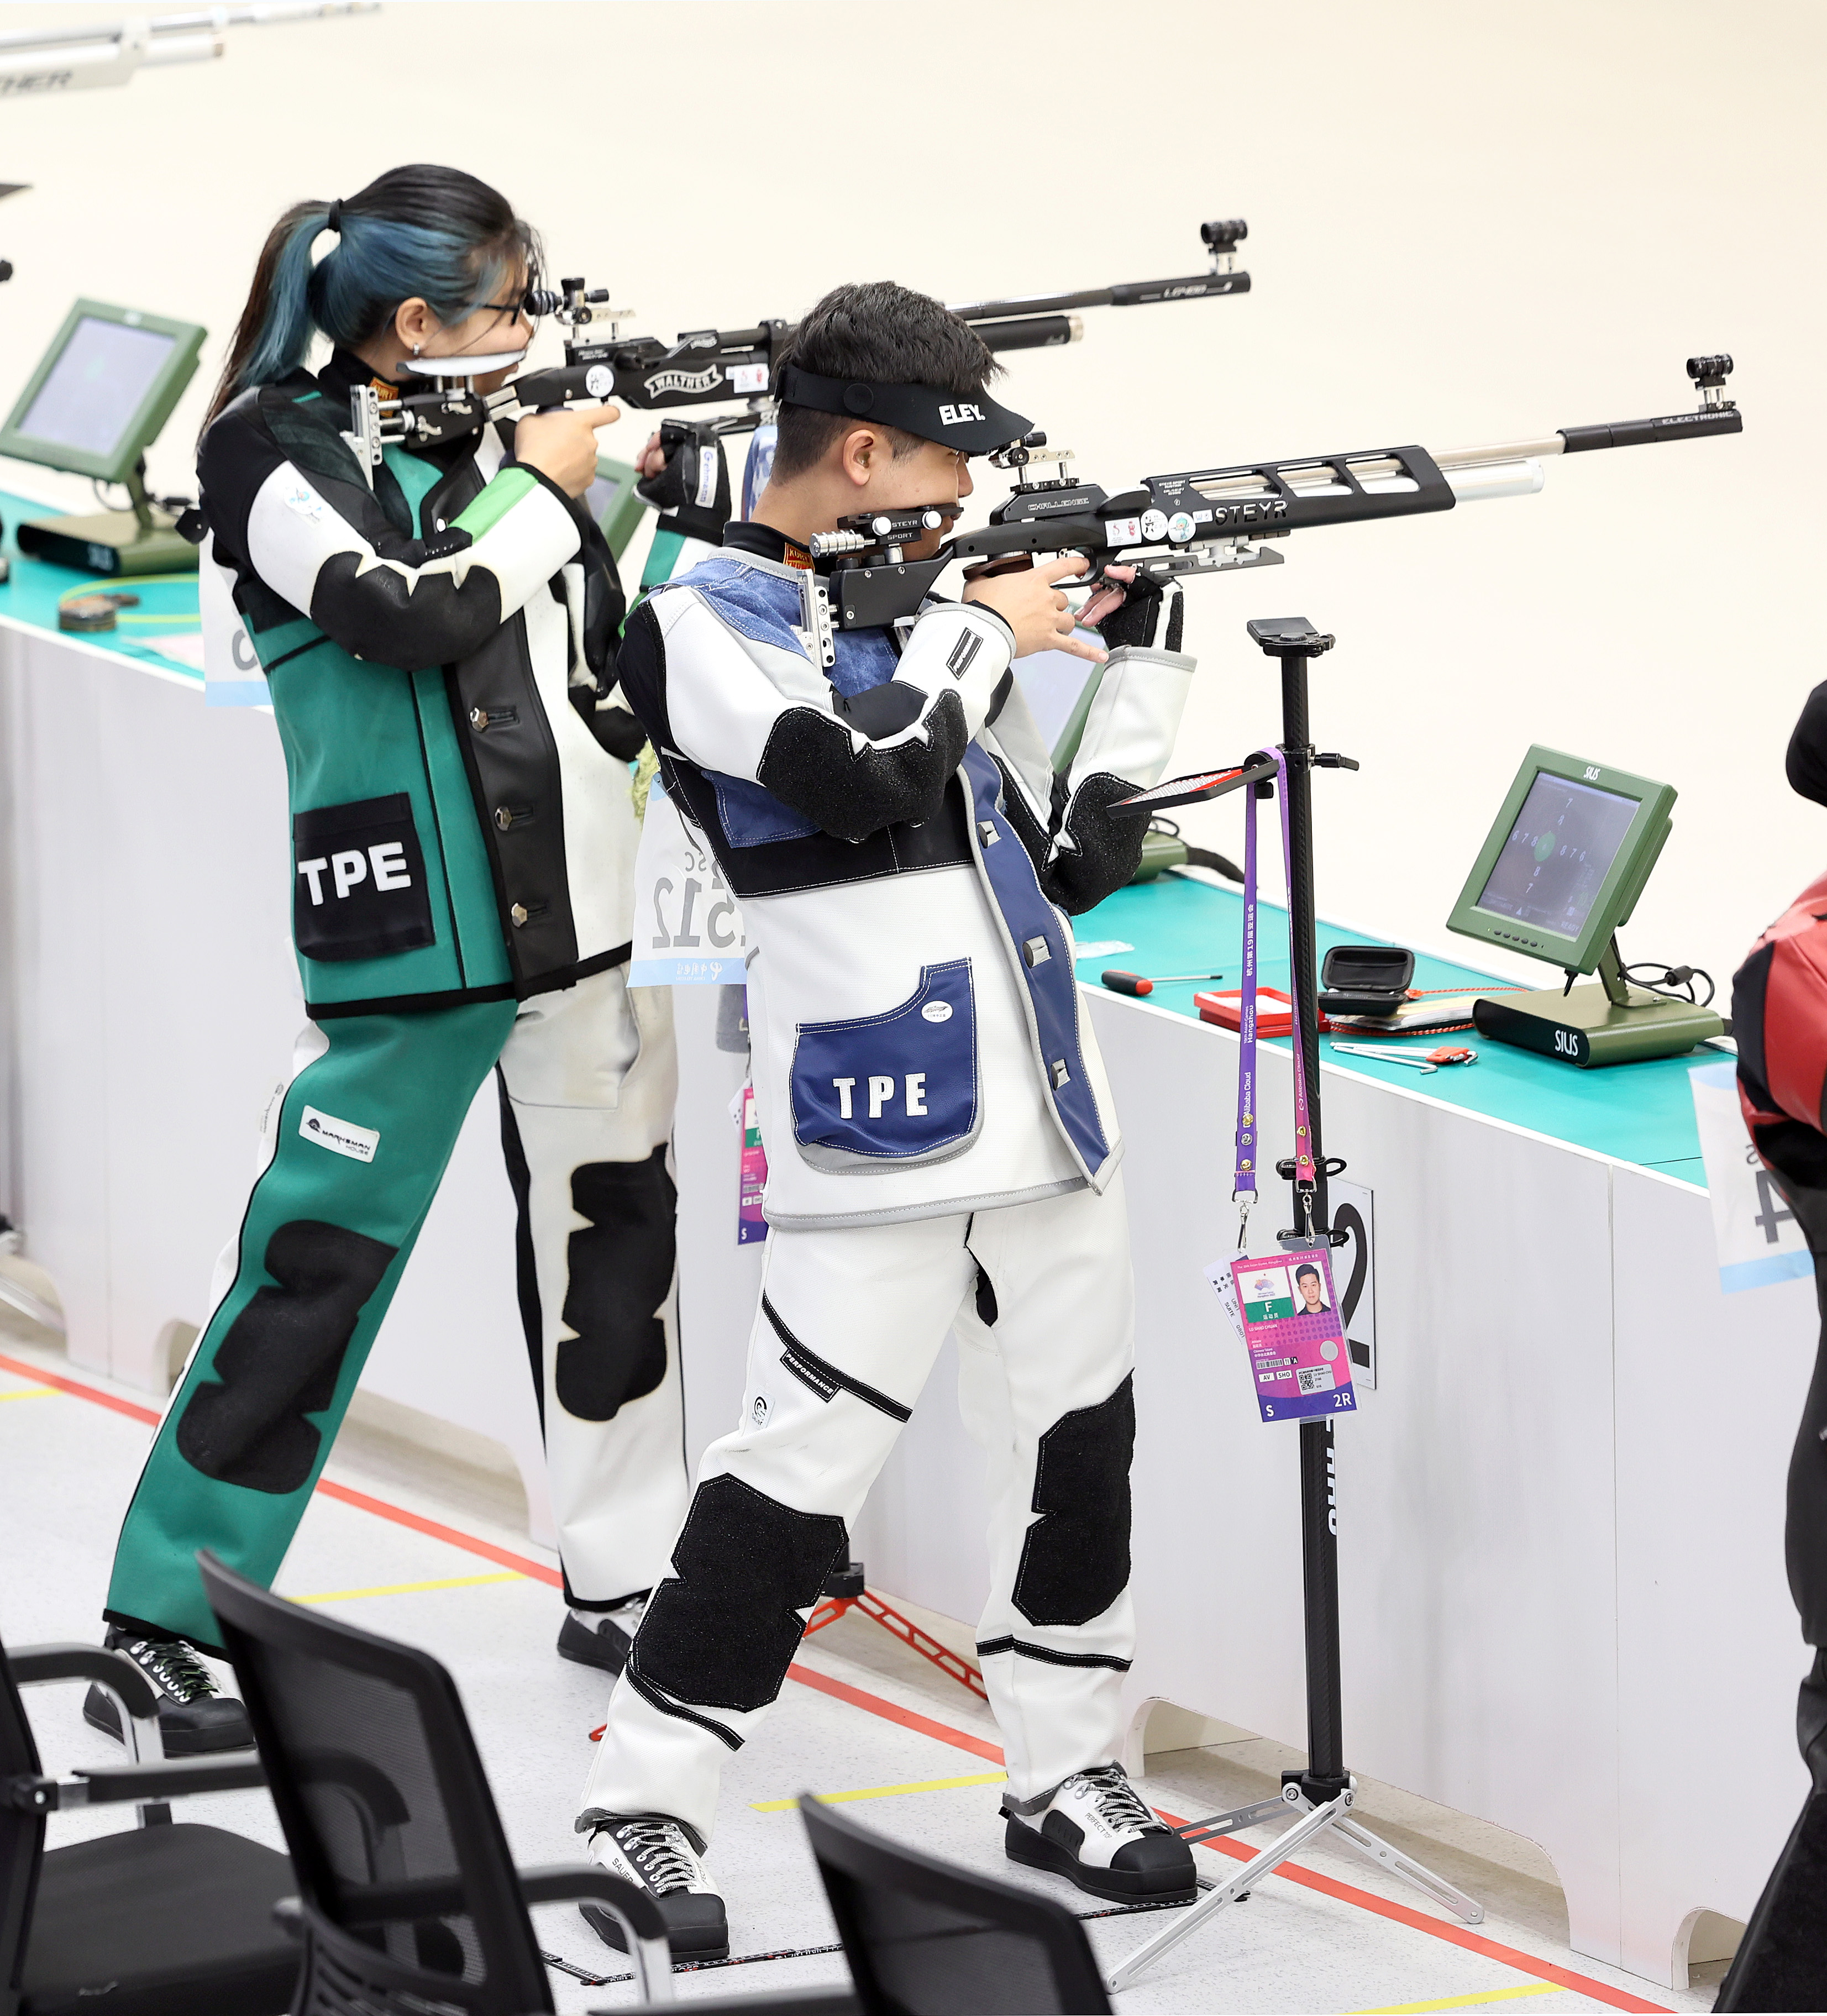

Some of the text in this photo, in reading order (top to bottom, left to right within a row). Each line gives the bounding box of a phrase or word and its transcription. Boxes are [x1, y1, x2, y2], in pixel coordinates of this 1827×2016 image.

[654, 375, 711, 389] WALTHER
[939, 403, 984, 426] ELEY
[1661, 411, 1734, 425] ELECTRONIC
[1028, 497, 1090, 511] CHALLENGE
[1215, 500, 1289, 526] STEYR
[891, 519, 918, 528] STEYR
[887, 532, 913, 540] SPORT
[1583, 765, 1601, 781] SIUS
[1566, 798, 1574, 808] 7
[1557, 814, 1565, 825] 8
[1512, 830, 1519, 841] 6
[1521, 833, 1530, 843] 7
[1531, 836, 1539, 847] 8
[1560, 845, 1567, 856] 8
[1569, 848, 1577, 858] 7
[298, 841, 412, 906] TPE
[1534, 866, 1541, 877] 8
[1526, 883, 1534, 893] 7
[1246, 904, 1254, 977] 杭州第19届亚运会
[1555, 1029, 1579, 1057] SIUS
[833, 1073, 928, 1119] TPE
[1243, 1091, 1252, 1115] Alibaba
[322, 1130, 371, 1150] MARKSMAN
[345, 1145, 369, 1156] HOUSE
[741, 1227, 747, 1240] S
[1264, 1301, 1272, 1312] F
[1225, 1301, 1235, 1317] SUITE
[1236, 1325, 1245, 1338] 0801
[785, 1353, 834, 1395] PERFORMANCE
[1332, 1392, 1352, 1408] 2R
[1266, 1405, 1274, 1417] S
[1084, 1812, 1106, 1834] PERFECT
